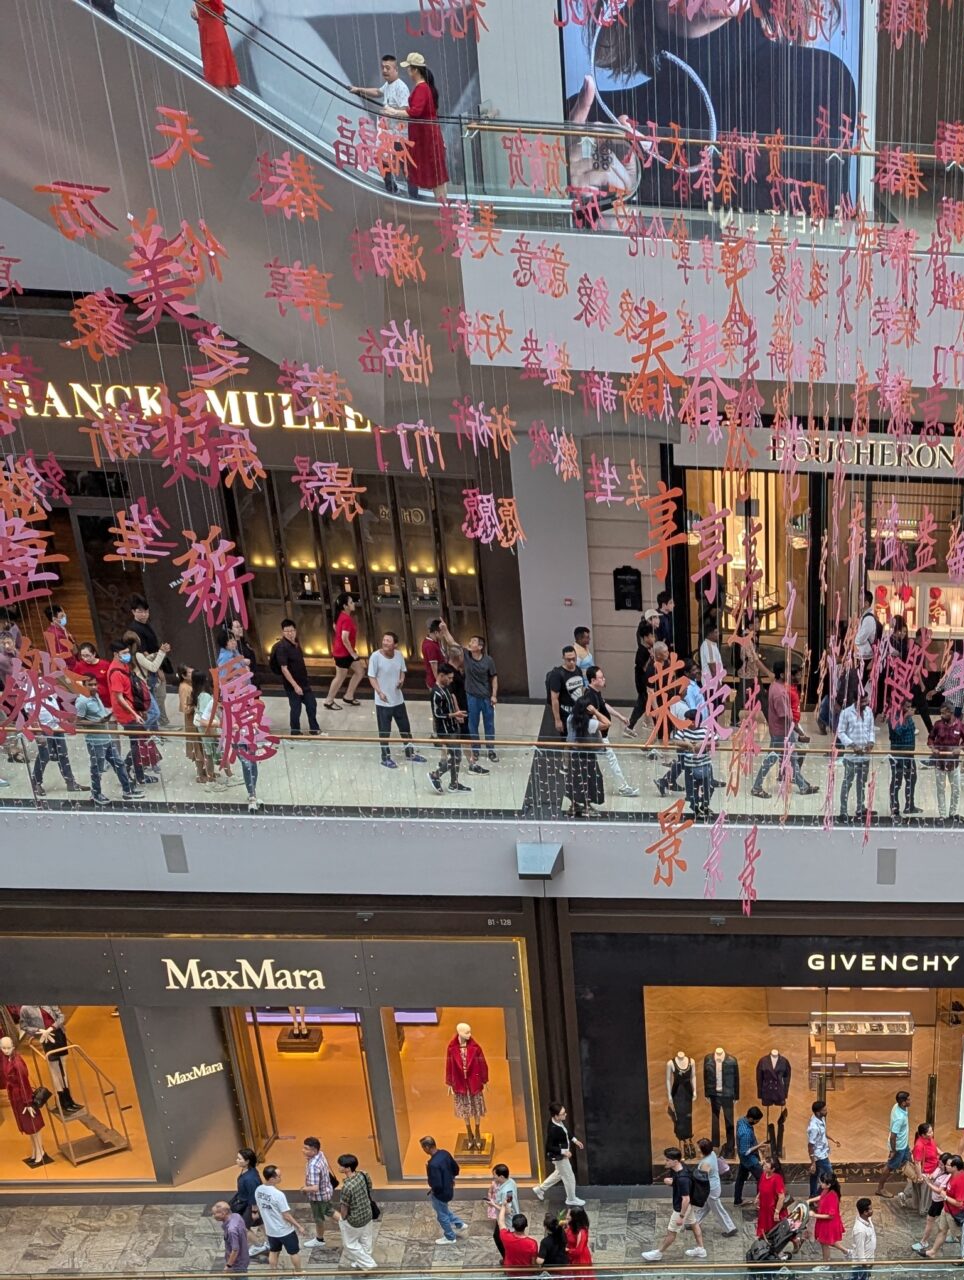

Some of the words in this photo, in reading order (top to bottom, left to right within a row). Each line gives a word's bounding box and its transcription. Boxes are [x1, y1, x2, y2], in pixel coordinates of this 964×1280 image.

[624, 300, 686, 413] 春
[678, 314, 739, 428] 春
[770, 436, 955, 468] BOUCHERON
[634, 481, 688, 583] 享
[690, 502, 733, 604] 享
[645, 652, 692, 748] 荣
[645, 798, 694, 887] 景
[161, 958, 326, 990] MaxMara
[807, 953, 960, 972] GIVENCHY
[165, 1061, 225, 1088] MaxMara
